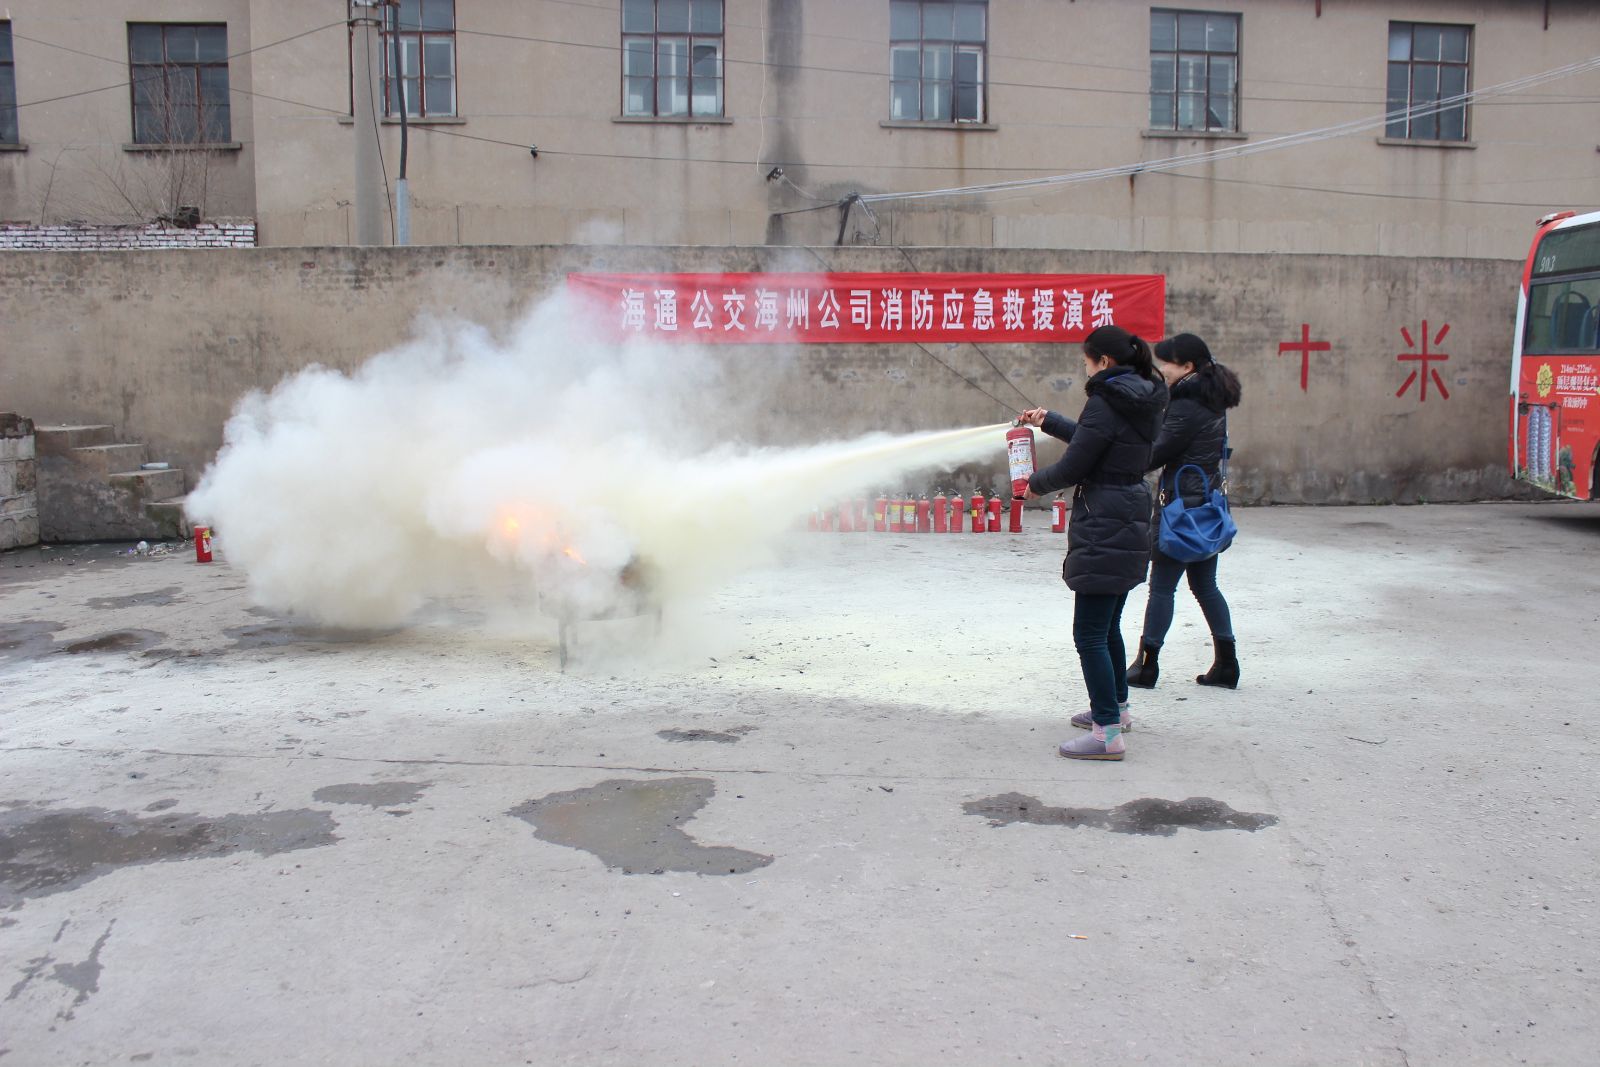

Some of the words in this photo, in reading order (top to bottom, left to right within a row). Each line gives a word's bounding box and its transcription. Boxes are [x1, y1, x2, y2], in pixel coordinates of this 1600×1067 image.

[621, 287, 1114, 332] 海通公交海州公司消防应急救援演练
